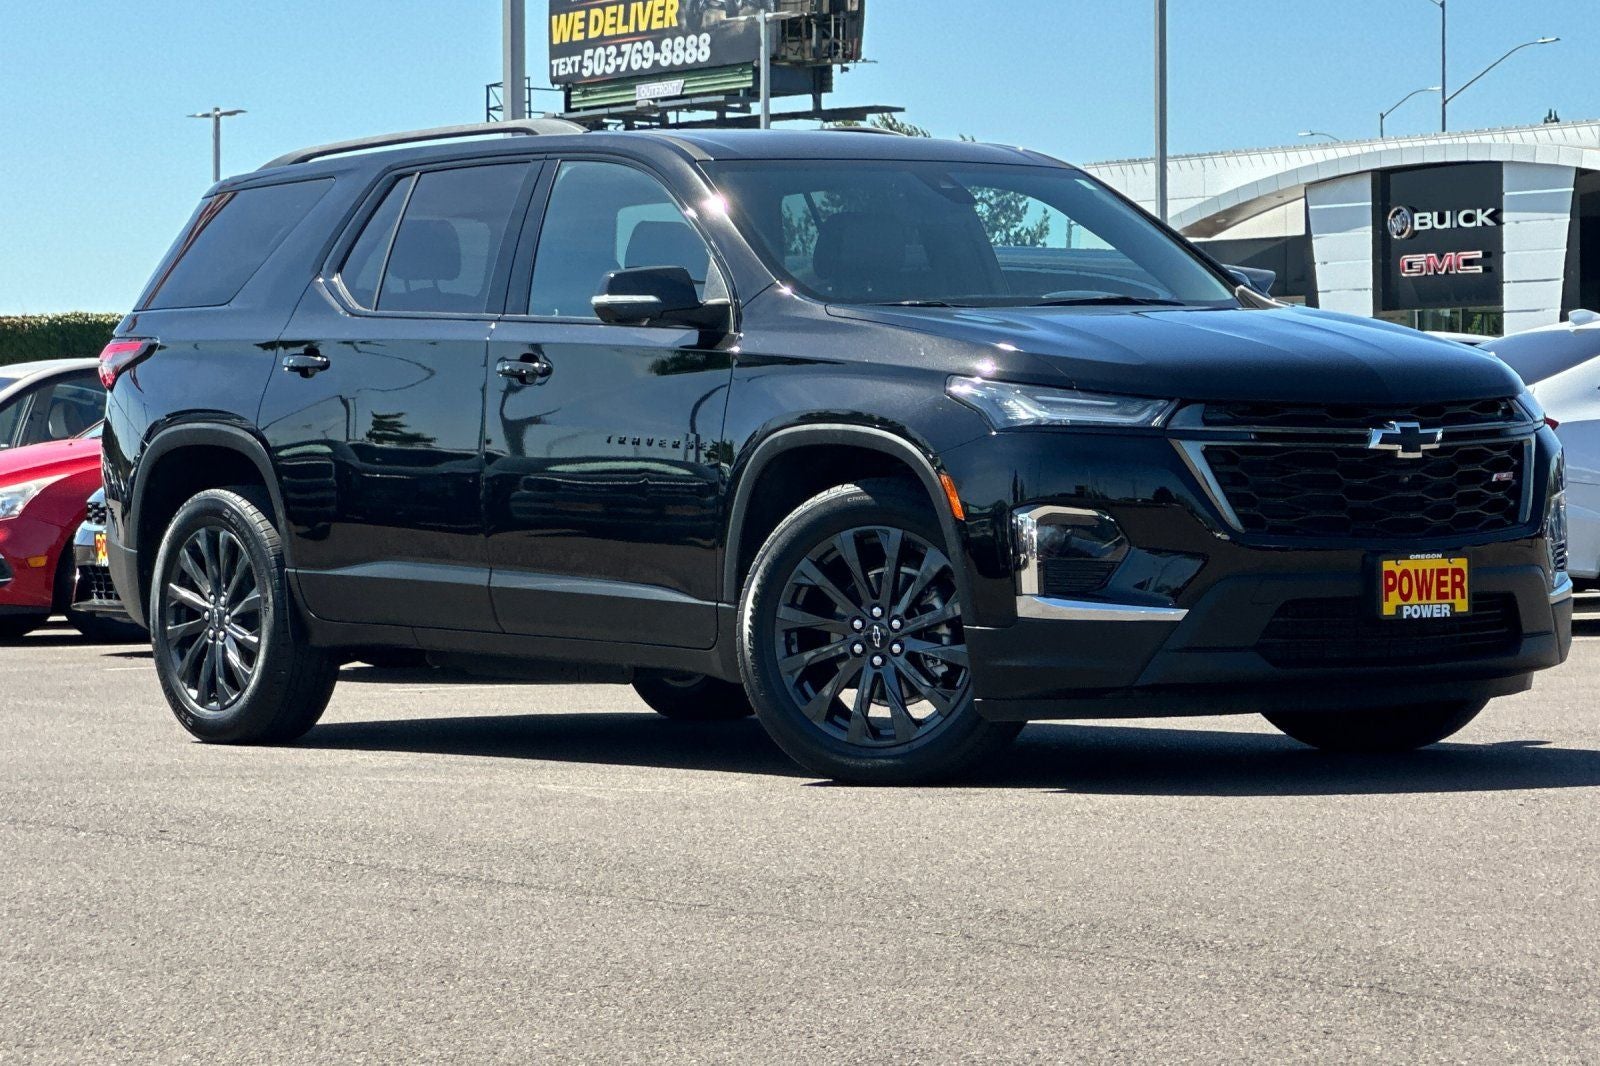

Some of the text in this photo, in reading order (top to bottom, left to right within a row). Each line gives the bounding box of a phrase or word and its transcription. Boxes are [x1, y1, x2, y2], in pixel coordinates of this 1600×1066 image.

[552, 0, 680, 45] WE DELIVER
[551, 32, 711, 78] TEXT 503-769-8888
[1413, 208, 1497, 231] BUICK
[1400, 250, 1483, 278] GMC
[1383, 567, 1466, 603] POWER
[1402, 603, 1451, 619] POWER
